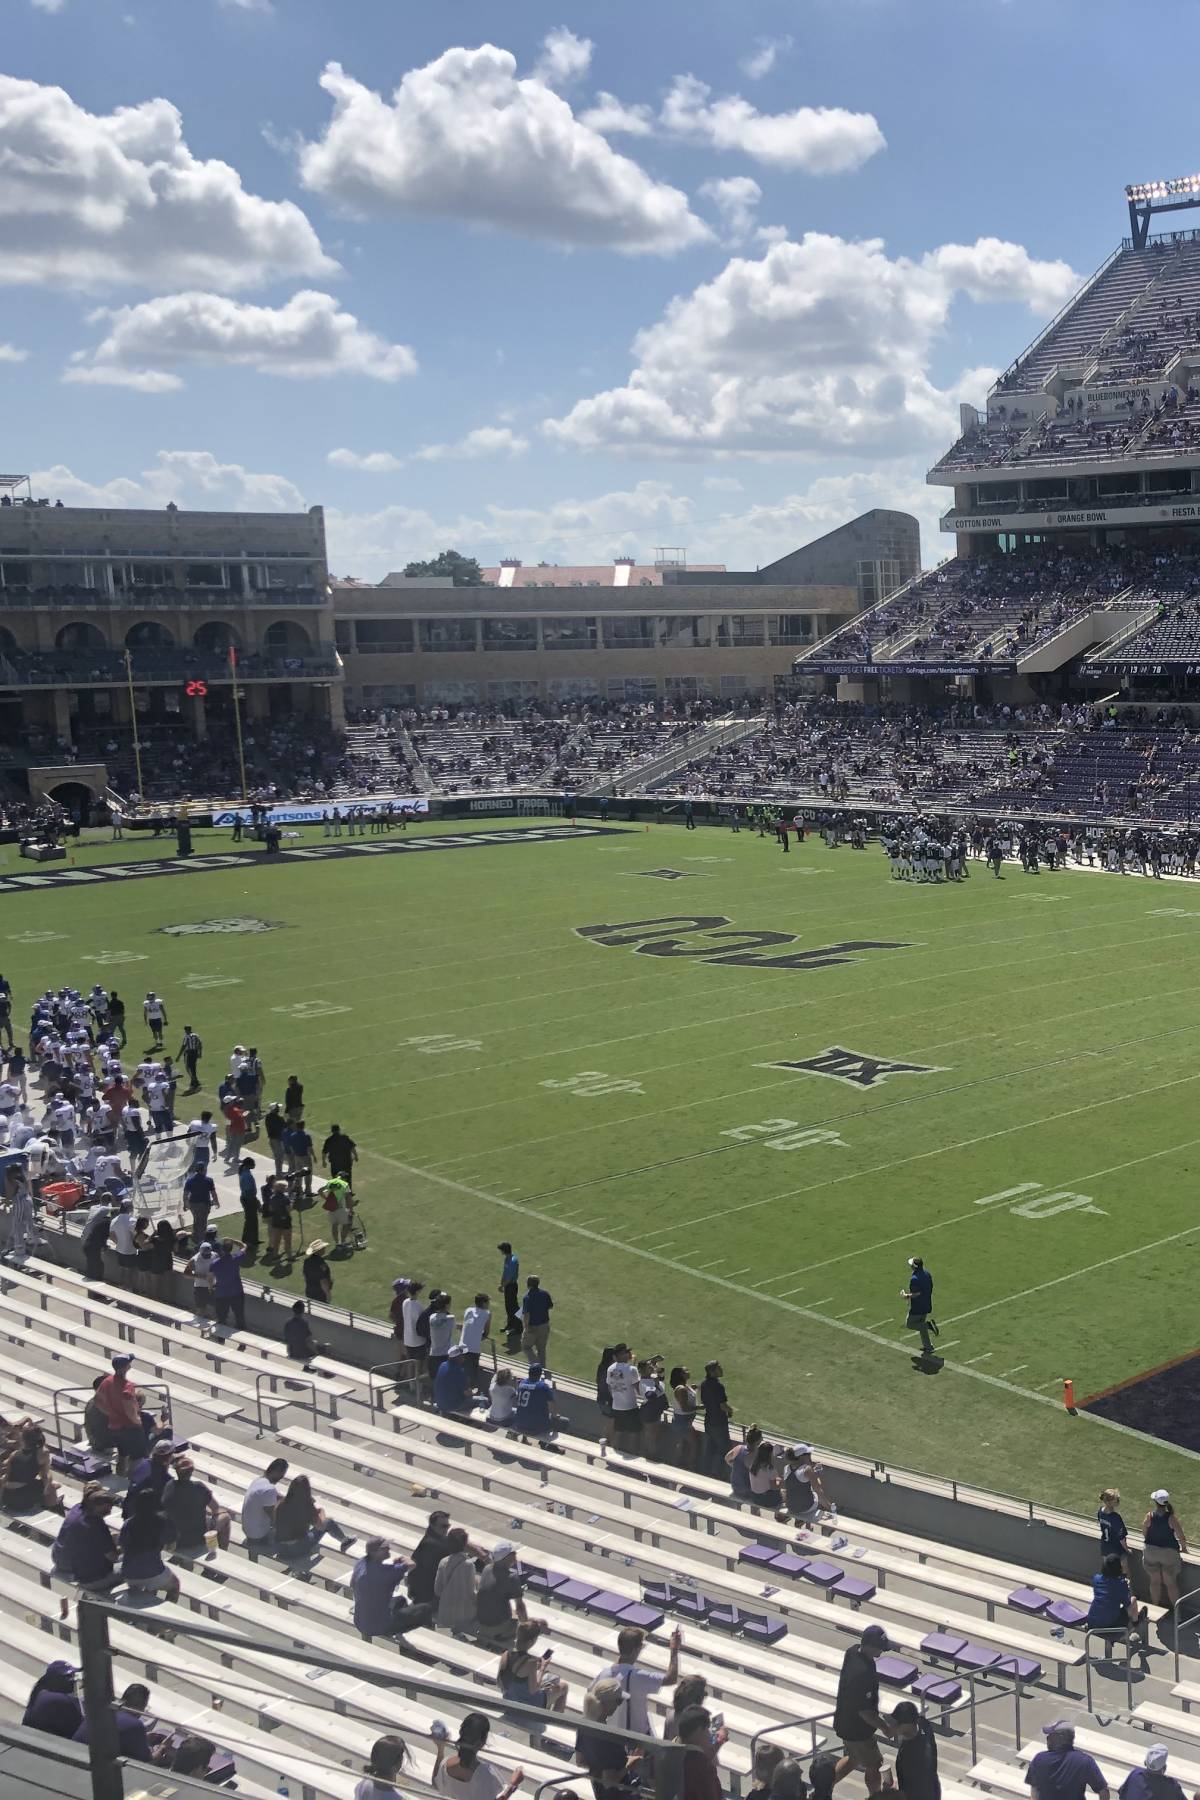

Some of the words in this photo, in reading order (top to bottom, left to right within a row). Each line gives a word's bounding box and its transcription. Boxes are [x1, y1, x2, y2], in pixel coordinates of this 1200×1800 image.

[1131, 387, 1151, 398] BOWL
[1057, 514, 1084, 525] ORANGE
[1085, 511, 1107, 523] BOWL
[1172, 507, 1196, 518] FIESTA
[955, 519, 981, 530] COTTON
[982, 516, 1002, 528] BOWL
[824, 666, 851, 674] MEMBERS
[852, 666, 863, 674] GET
[863, 666, 878, 674] FREE
[1130, 666, 1138, 674] 13
[1152, 666, 1162, 675] 78
[186, 680, 207, 696] 25
[470, 800, 513, 811] HORNED
[516, 799, 550, 810] FROGS
[245, 809, 322, 822] Abertsons
[279, 827, 597, 857] FROGS
[570, 916, 928, 970] TCU
[399, 1033, 482, 1053] 40
[539, 1070, 643, 1097] 30
[719, 1118, 842, 1150] 20
[973, 1182, 1094, 1219] 10
